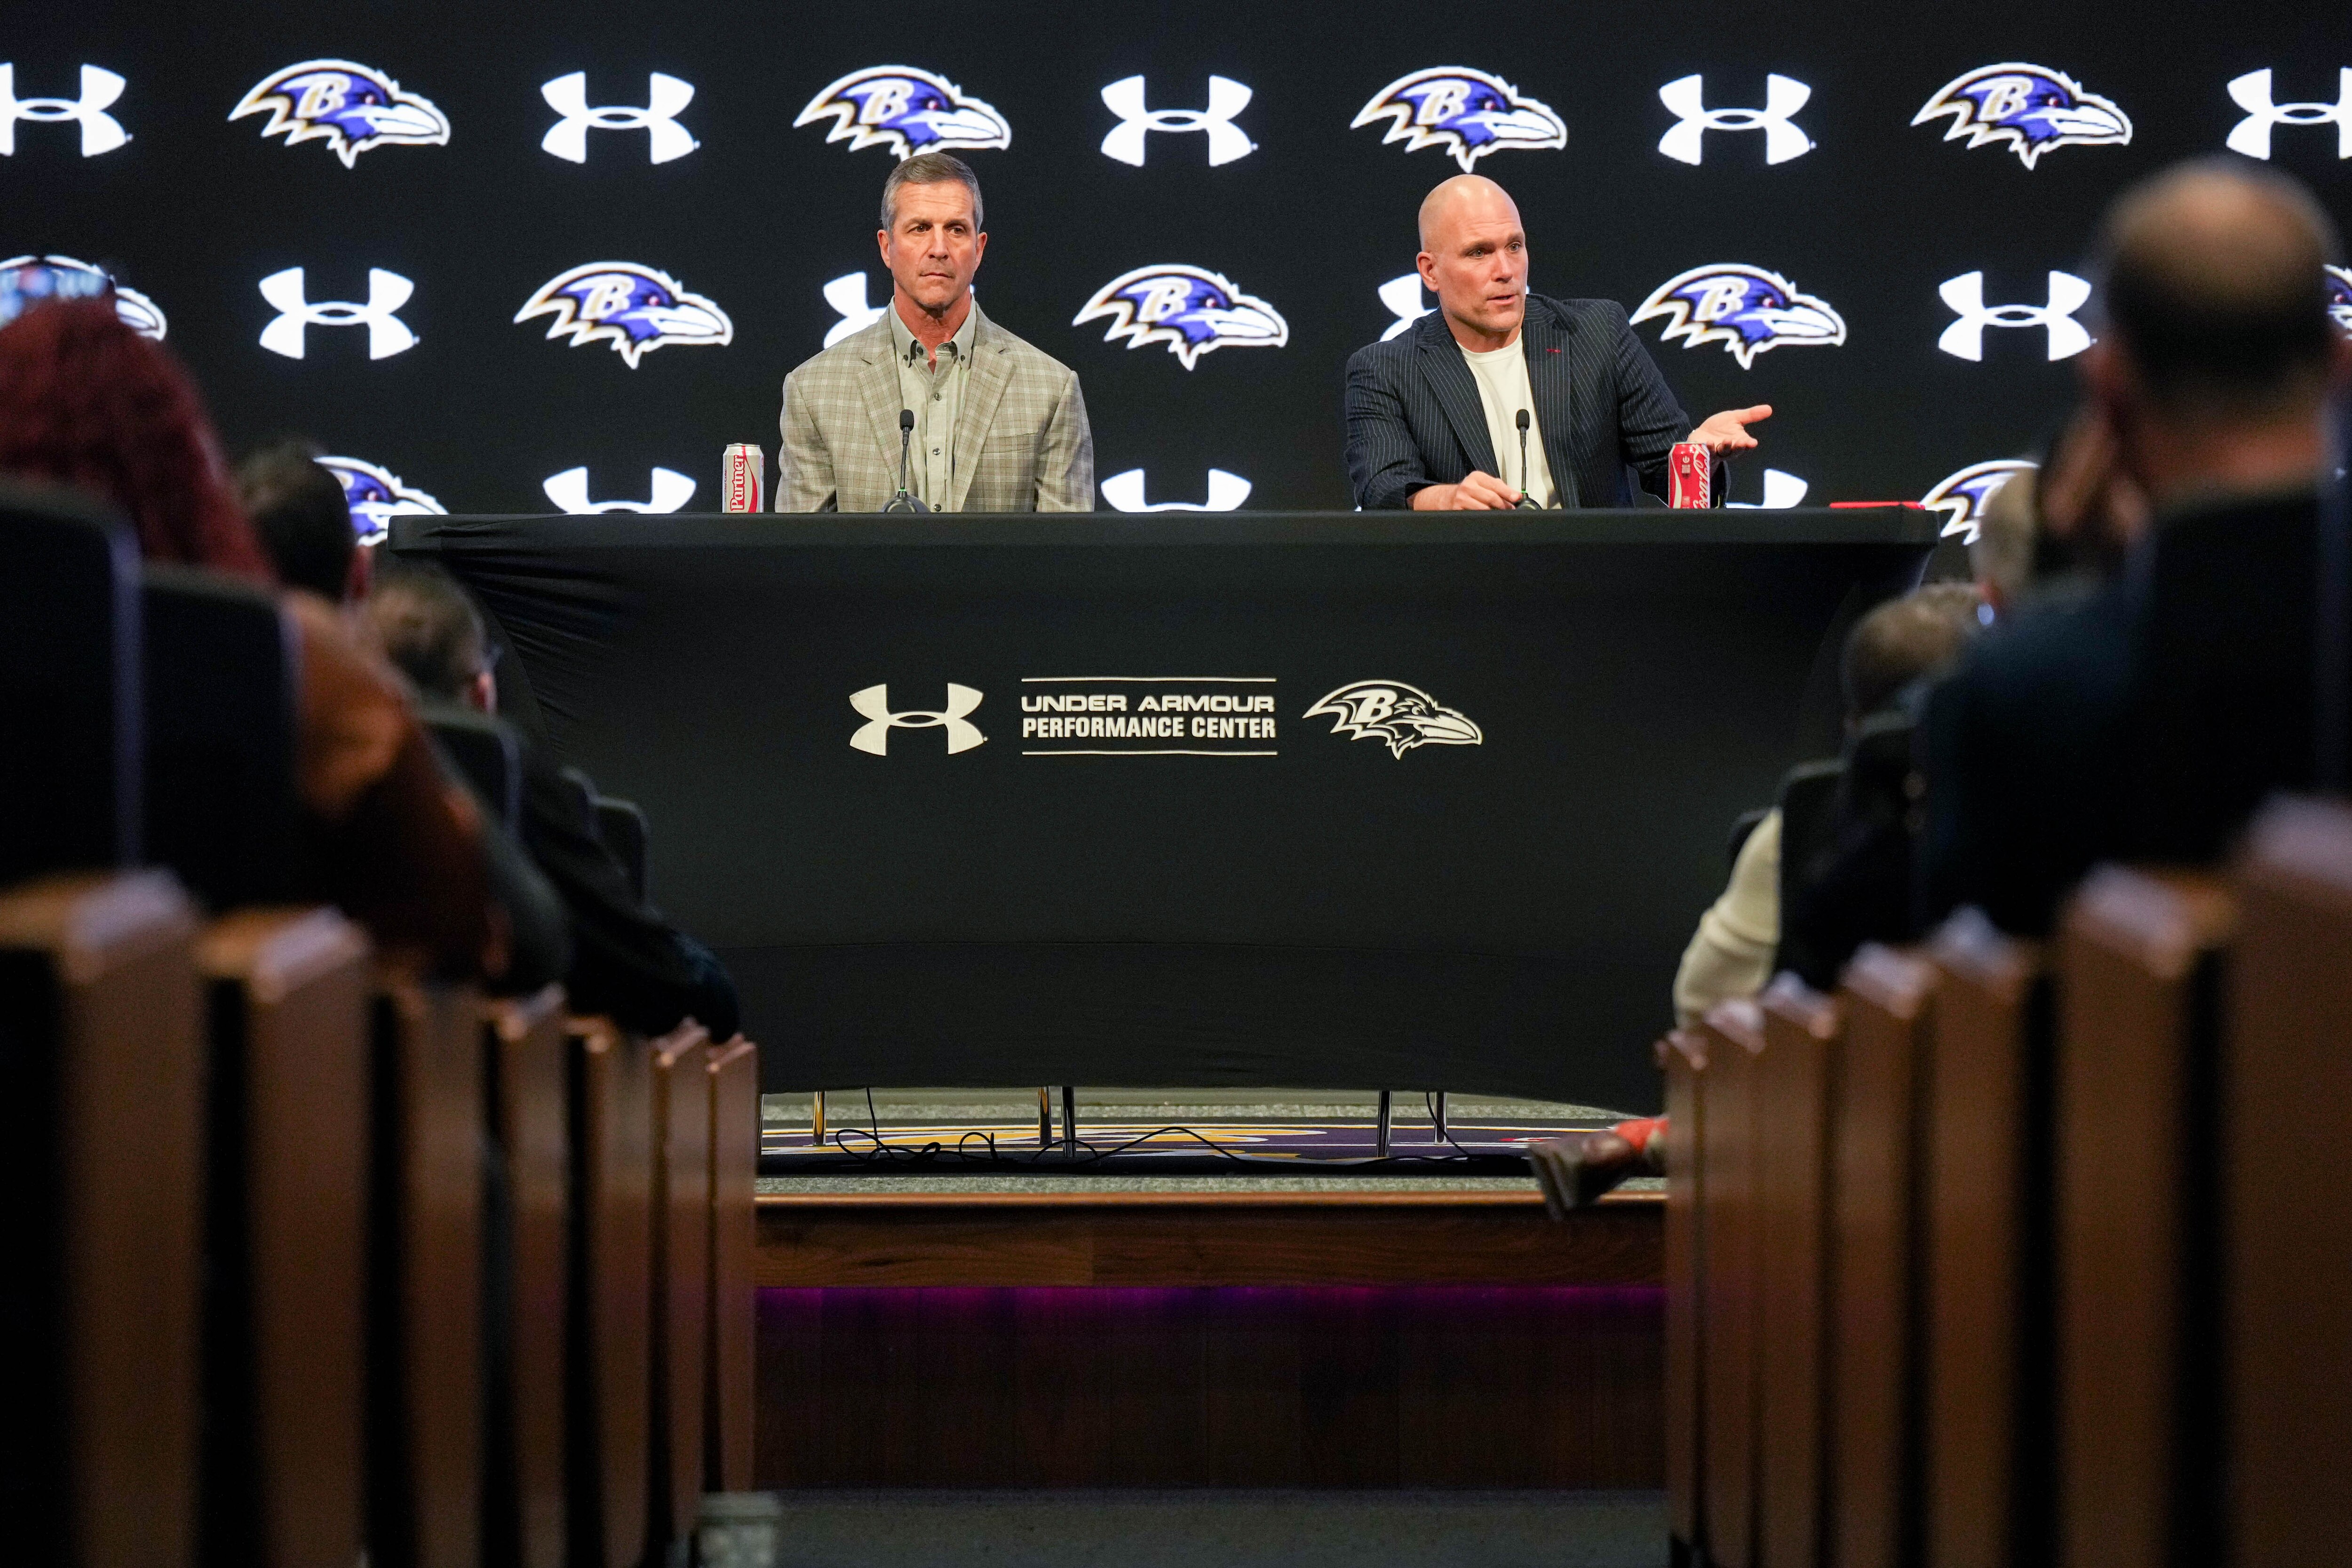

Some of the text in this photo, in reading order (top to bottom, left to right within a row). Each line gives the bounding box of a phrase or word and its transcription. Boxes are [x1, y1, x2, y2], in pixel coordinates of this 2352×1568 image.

[730, 454, 745, 511] Partner
[1021, 695, 1274, 712] UNDER ARMOUR
[1342, 689, 1398, 723] B
[1023, 717, 1275, 738] PERFORMANCE CENTER
